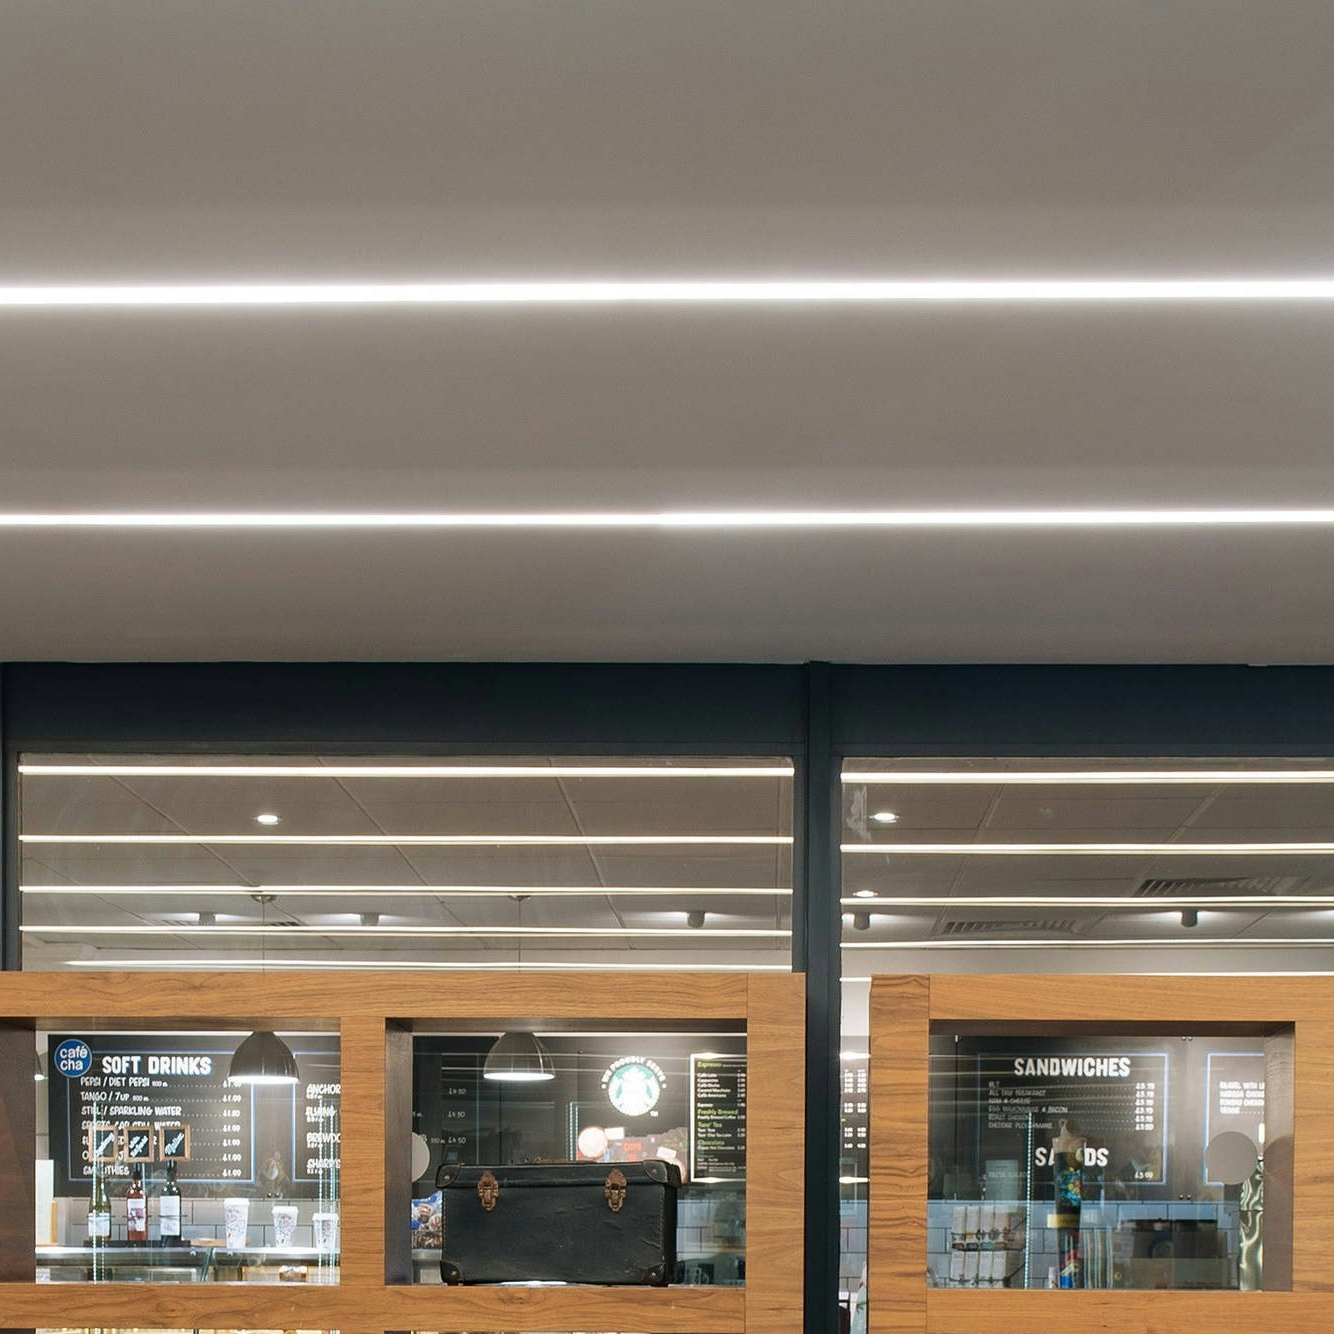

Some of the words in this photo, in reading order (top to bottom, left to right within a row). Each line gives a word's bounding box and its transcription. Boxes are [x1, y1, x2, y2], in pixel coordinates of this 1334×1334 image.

[60, 1045, 88, 1059] café
[60, 1059, 83, 1071] cha
[102, 1056, 142, 1074] SOFT
[148, 1056, 213, 1075] DRINKS
[1014, 1057, 1131, 1077] SANDWICHES
[80, 1077, 102, 1087] PEPSI
[108, 1077, 126, 1087] DIET
[129, 1077, 150, 1087] PEPSI
[80, 1091, 107, 1101] TANGO
[109, 1106, 153, 1116] SPARKLING
[155, 1106, 182, 1116] WATER
[1035, 1147, 1109, 1167] SADS
